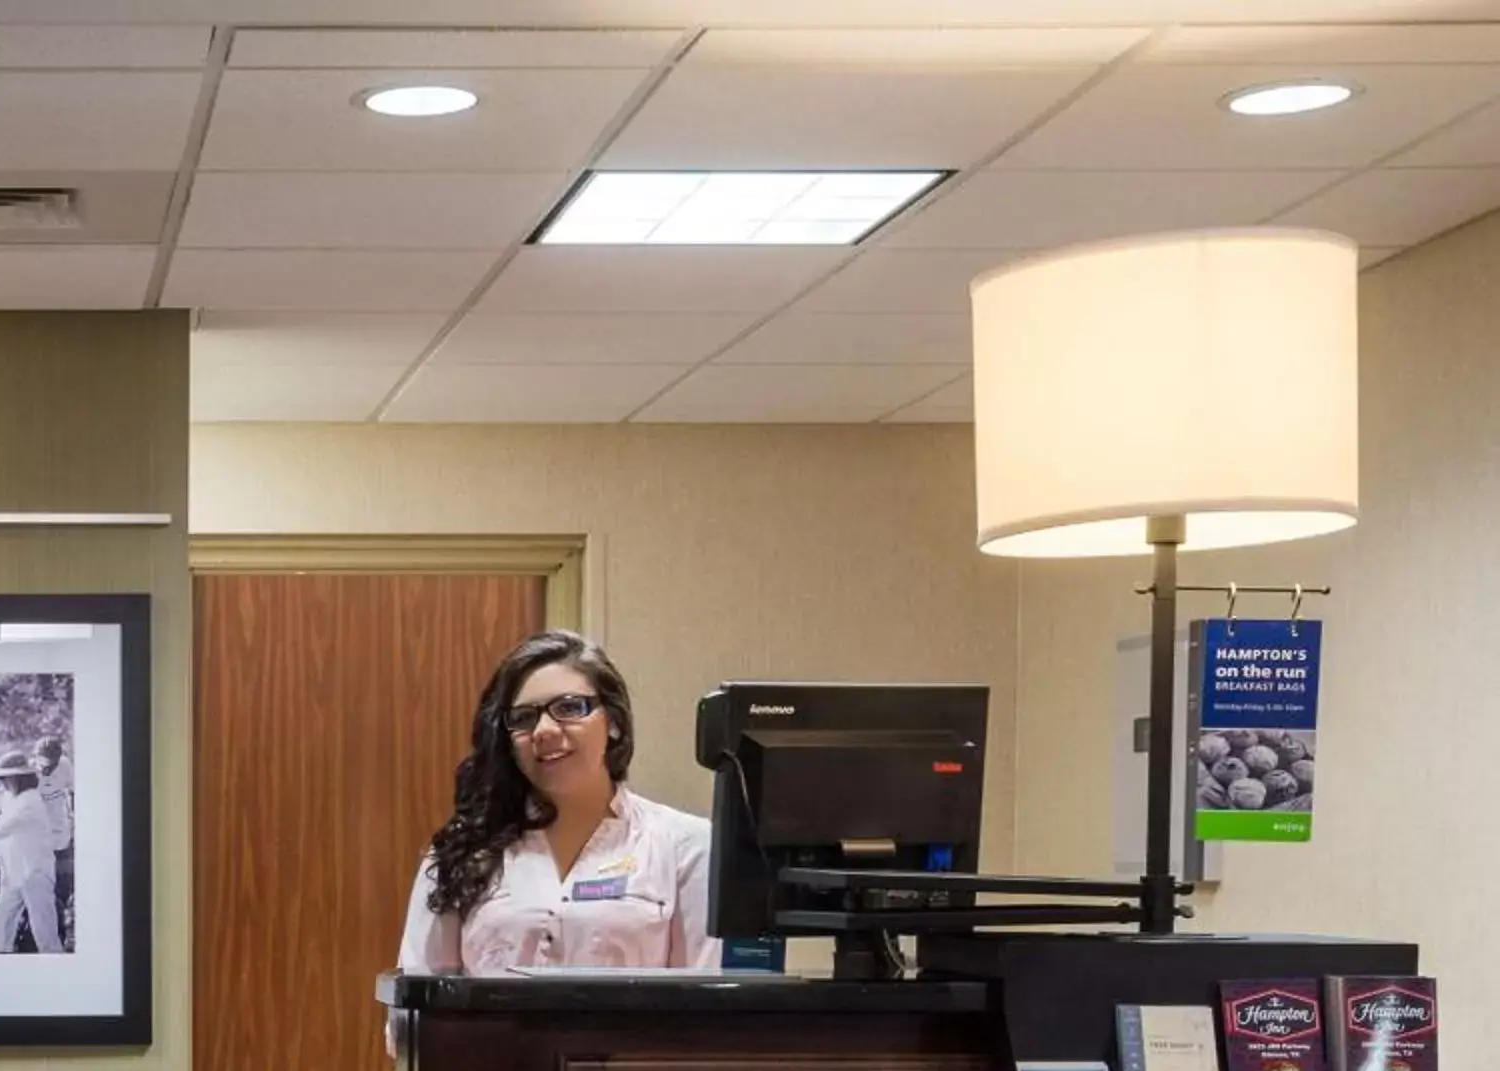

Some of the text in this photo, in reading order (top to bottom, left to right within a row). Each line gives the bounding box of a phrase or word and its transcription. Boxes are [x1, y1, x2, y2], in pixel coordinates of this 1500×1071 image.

[1216, 648, 1308, 661] HAMPTON'S
[1215, 664, 1306, 679] on the run
[1215, 681, 1274, 692] BREAKFAST
[749, 704, 796, 715] lenovo
[1237, 1000, 1316, 1025] Hampton
[1351, 999, 1430, 1023] Hampton
